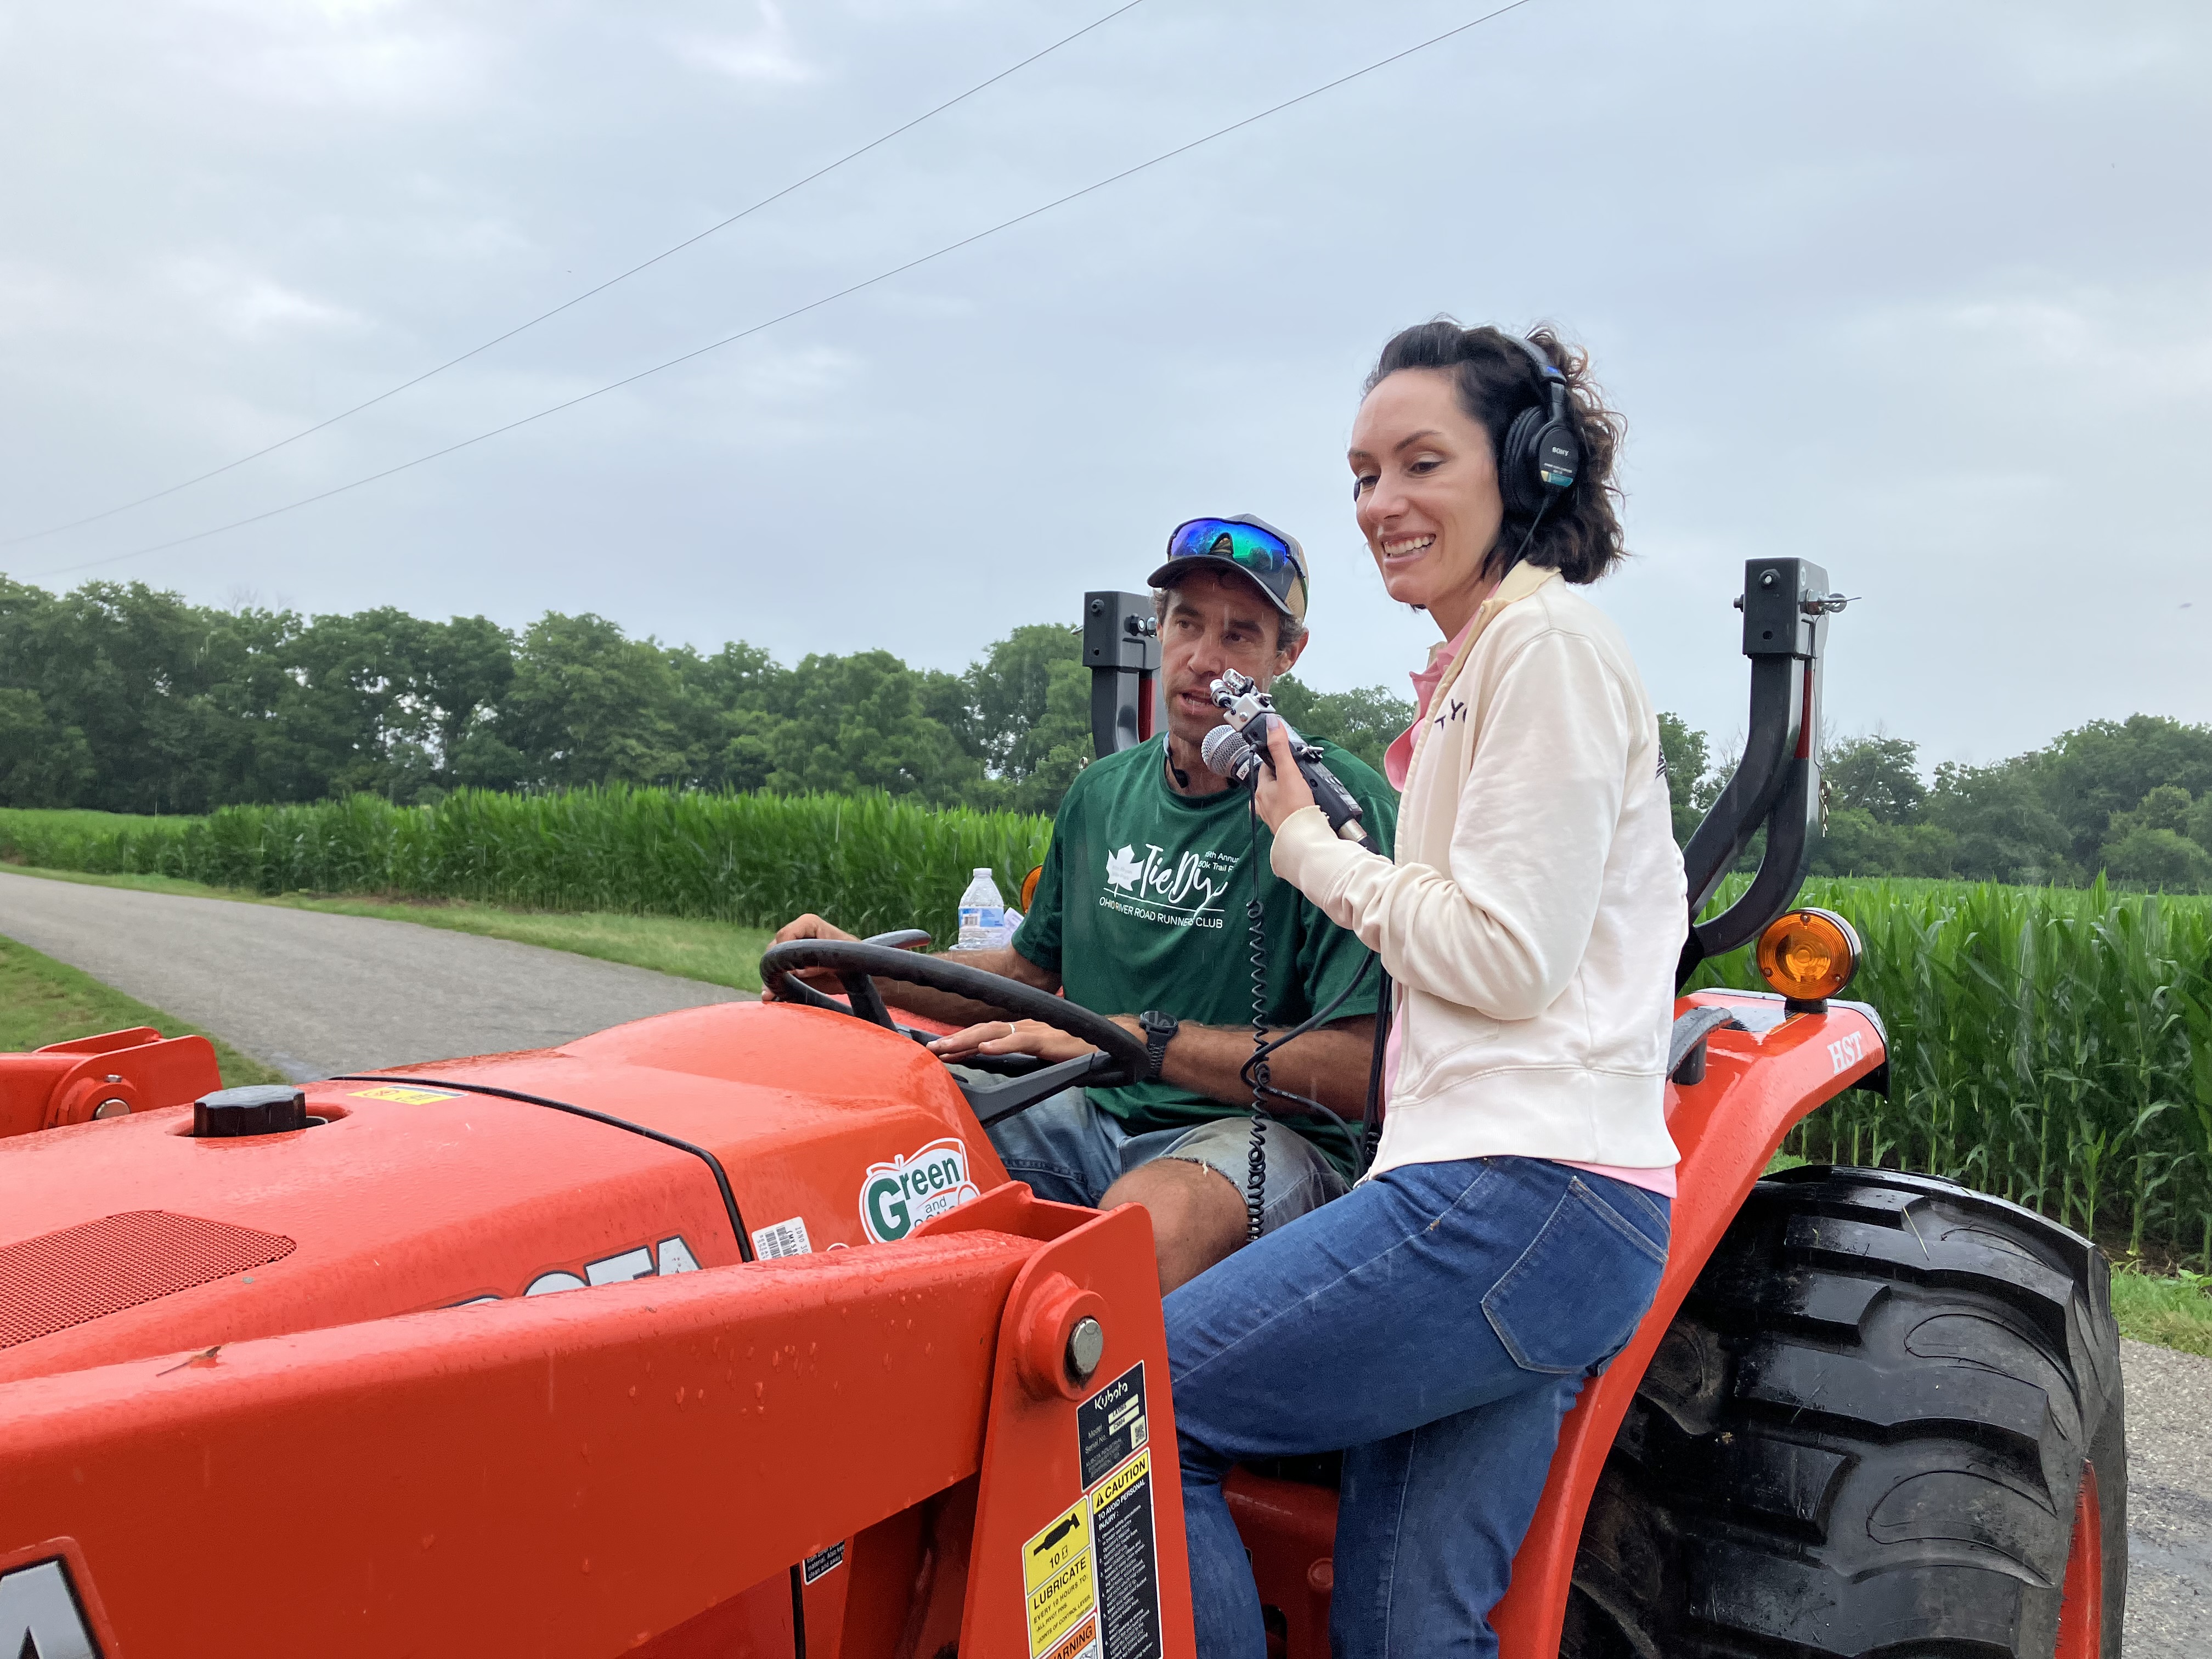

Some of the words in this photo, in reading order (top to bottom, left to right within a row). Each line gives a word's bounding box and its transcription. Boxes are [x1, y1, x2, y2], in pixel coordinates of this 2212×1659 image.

[1212, 862, 1227, 872] Trail
[1217, 853, 1239, 863] Annua
[1099, 896, 1115, 909] OHIO
[1115, 902, 1133, 916] RIVER
[1135, 907, 1156, 921] ROAD
[1195, 917, 1223, 929] CLUB
[1827, 1031, 1864, 1074] HST
[868, 1156, 961, 1242] Green
[925, 1195, 947, 1214] and
[1094, 1381, 1128, 1410] Kubota
[1105, 1457, 1146, 1499] CAUTION
[1098, 1511, 1105, 1521] TO
[1105, 1499, 1120, 1516] AVOID
[1120, 1479, 1146, 1503] PERSONAL
[1049, 1553, 1060, 1569] 10
[1034, 1556, 1086, 1611] LUBRICATE
[1034, 1604, 1051, 1624] EVERY
[1053, 1598, 1059, 1607] 10
[1060, 1582, 1078, 1602] HOURS
[1046, 1611, 1057, 1624] PIVOT
[1059, 1606, 1077, 1626] CONTROL
[1053, 1626, 1093, 1659] ARNING
